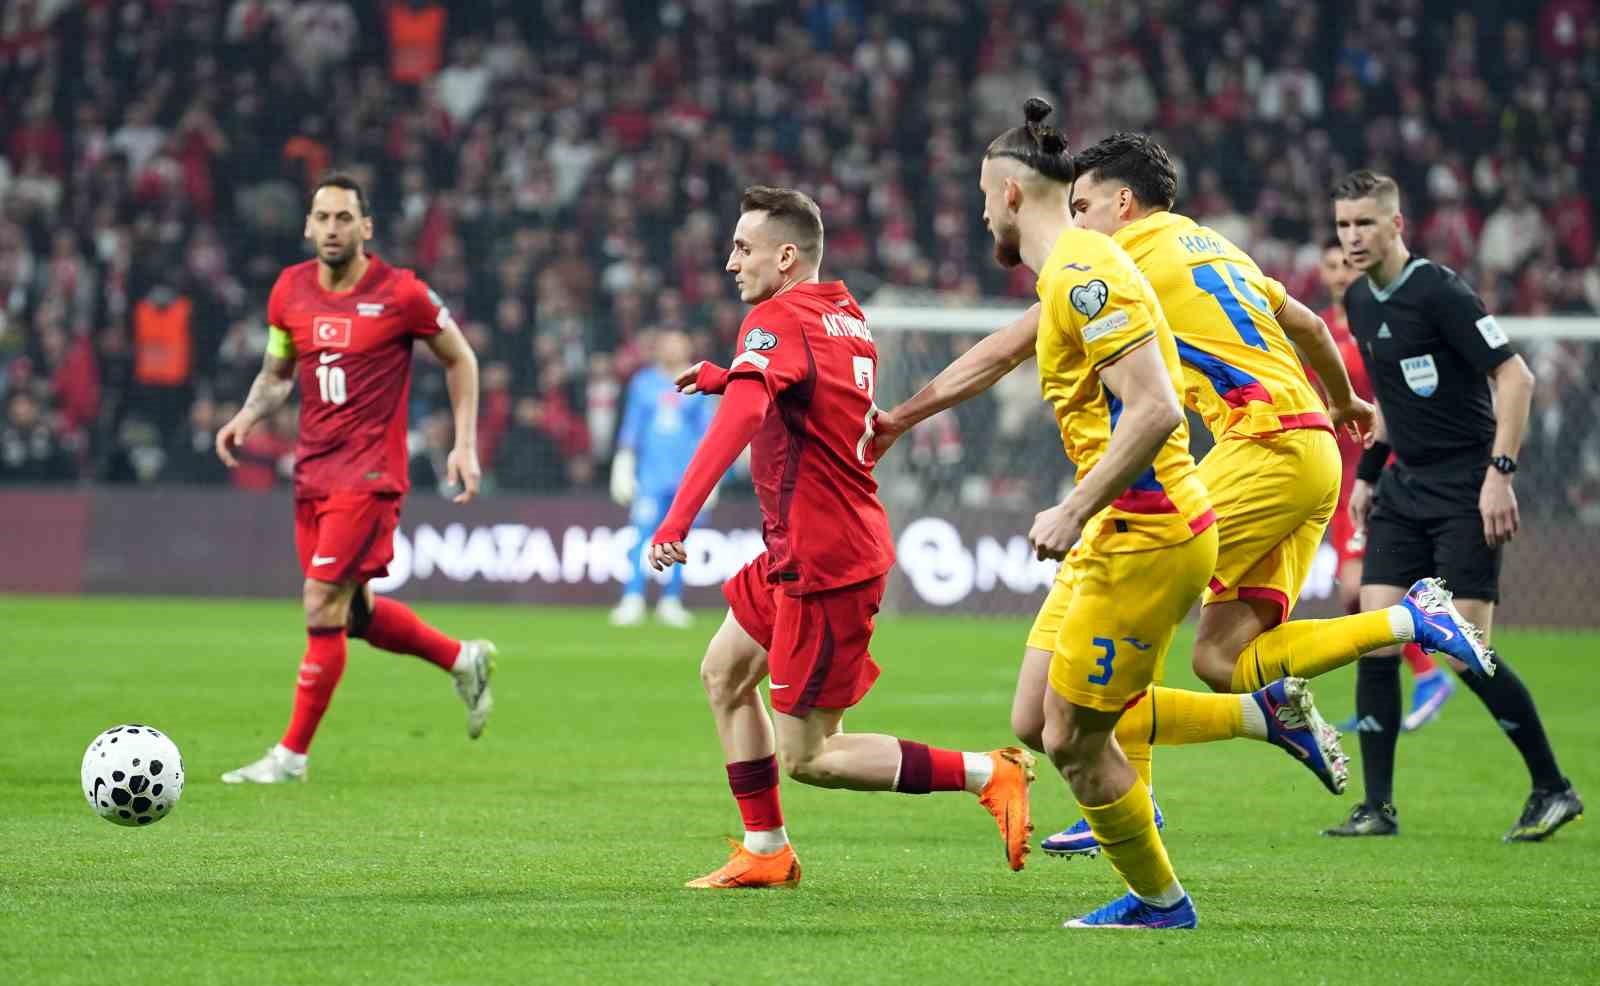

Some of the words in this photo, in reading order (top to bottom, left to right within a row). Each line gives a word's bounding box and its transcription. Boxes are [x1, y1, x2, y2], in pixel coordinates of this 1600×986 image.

[316, 365, 347, 405] 10
[1404, 358, 1431, 371] FIFA
[853, 356, 877, 465] 7
[413, 523, 561, 583] NATA
[1088, 637, 1115, 685] 3
